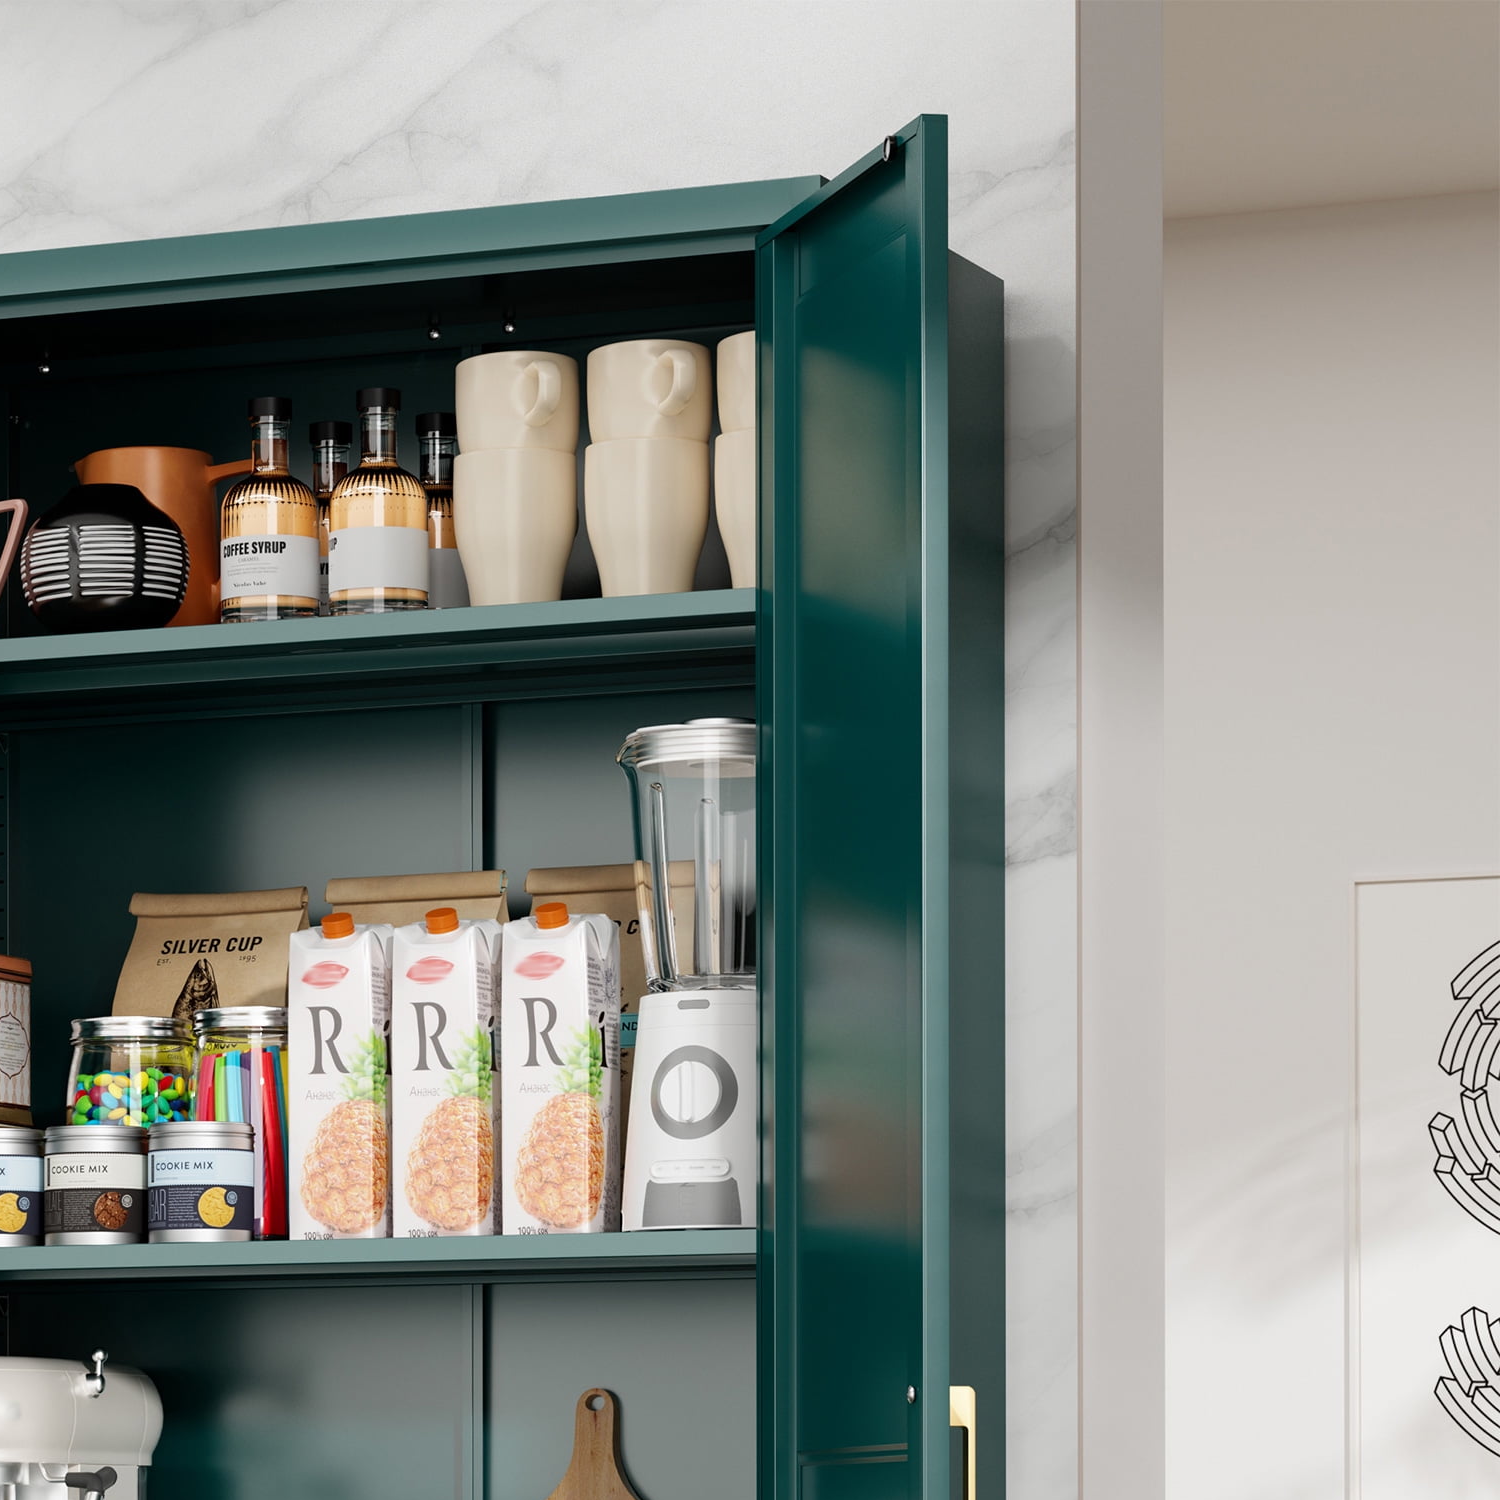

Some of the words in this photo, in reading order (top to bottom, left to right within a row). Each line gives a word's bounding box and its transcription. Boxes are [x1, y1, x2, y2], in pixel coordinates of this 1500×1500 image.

[223, 542, 250, 559] COFFEE
[251, 541, 287, 555] SYRUP
[161, 938, 221, 955] SILVER
[225, 936, 263, 952] CUP
[52, 1165, 85, 1174] COOKIE
[88, 1165, 108, 1173] MIX
[156, 1162, 190, 1171] COOKIE
[193, 1162, 214, 1170] MIX
